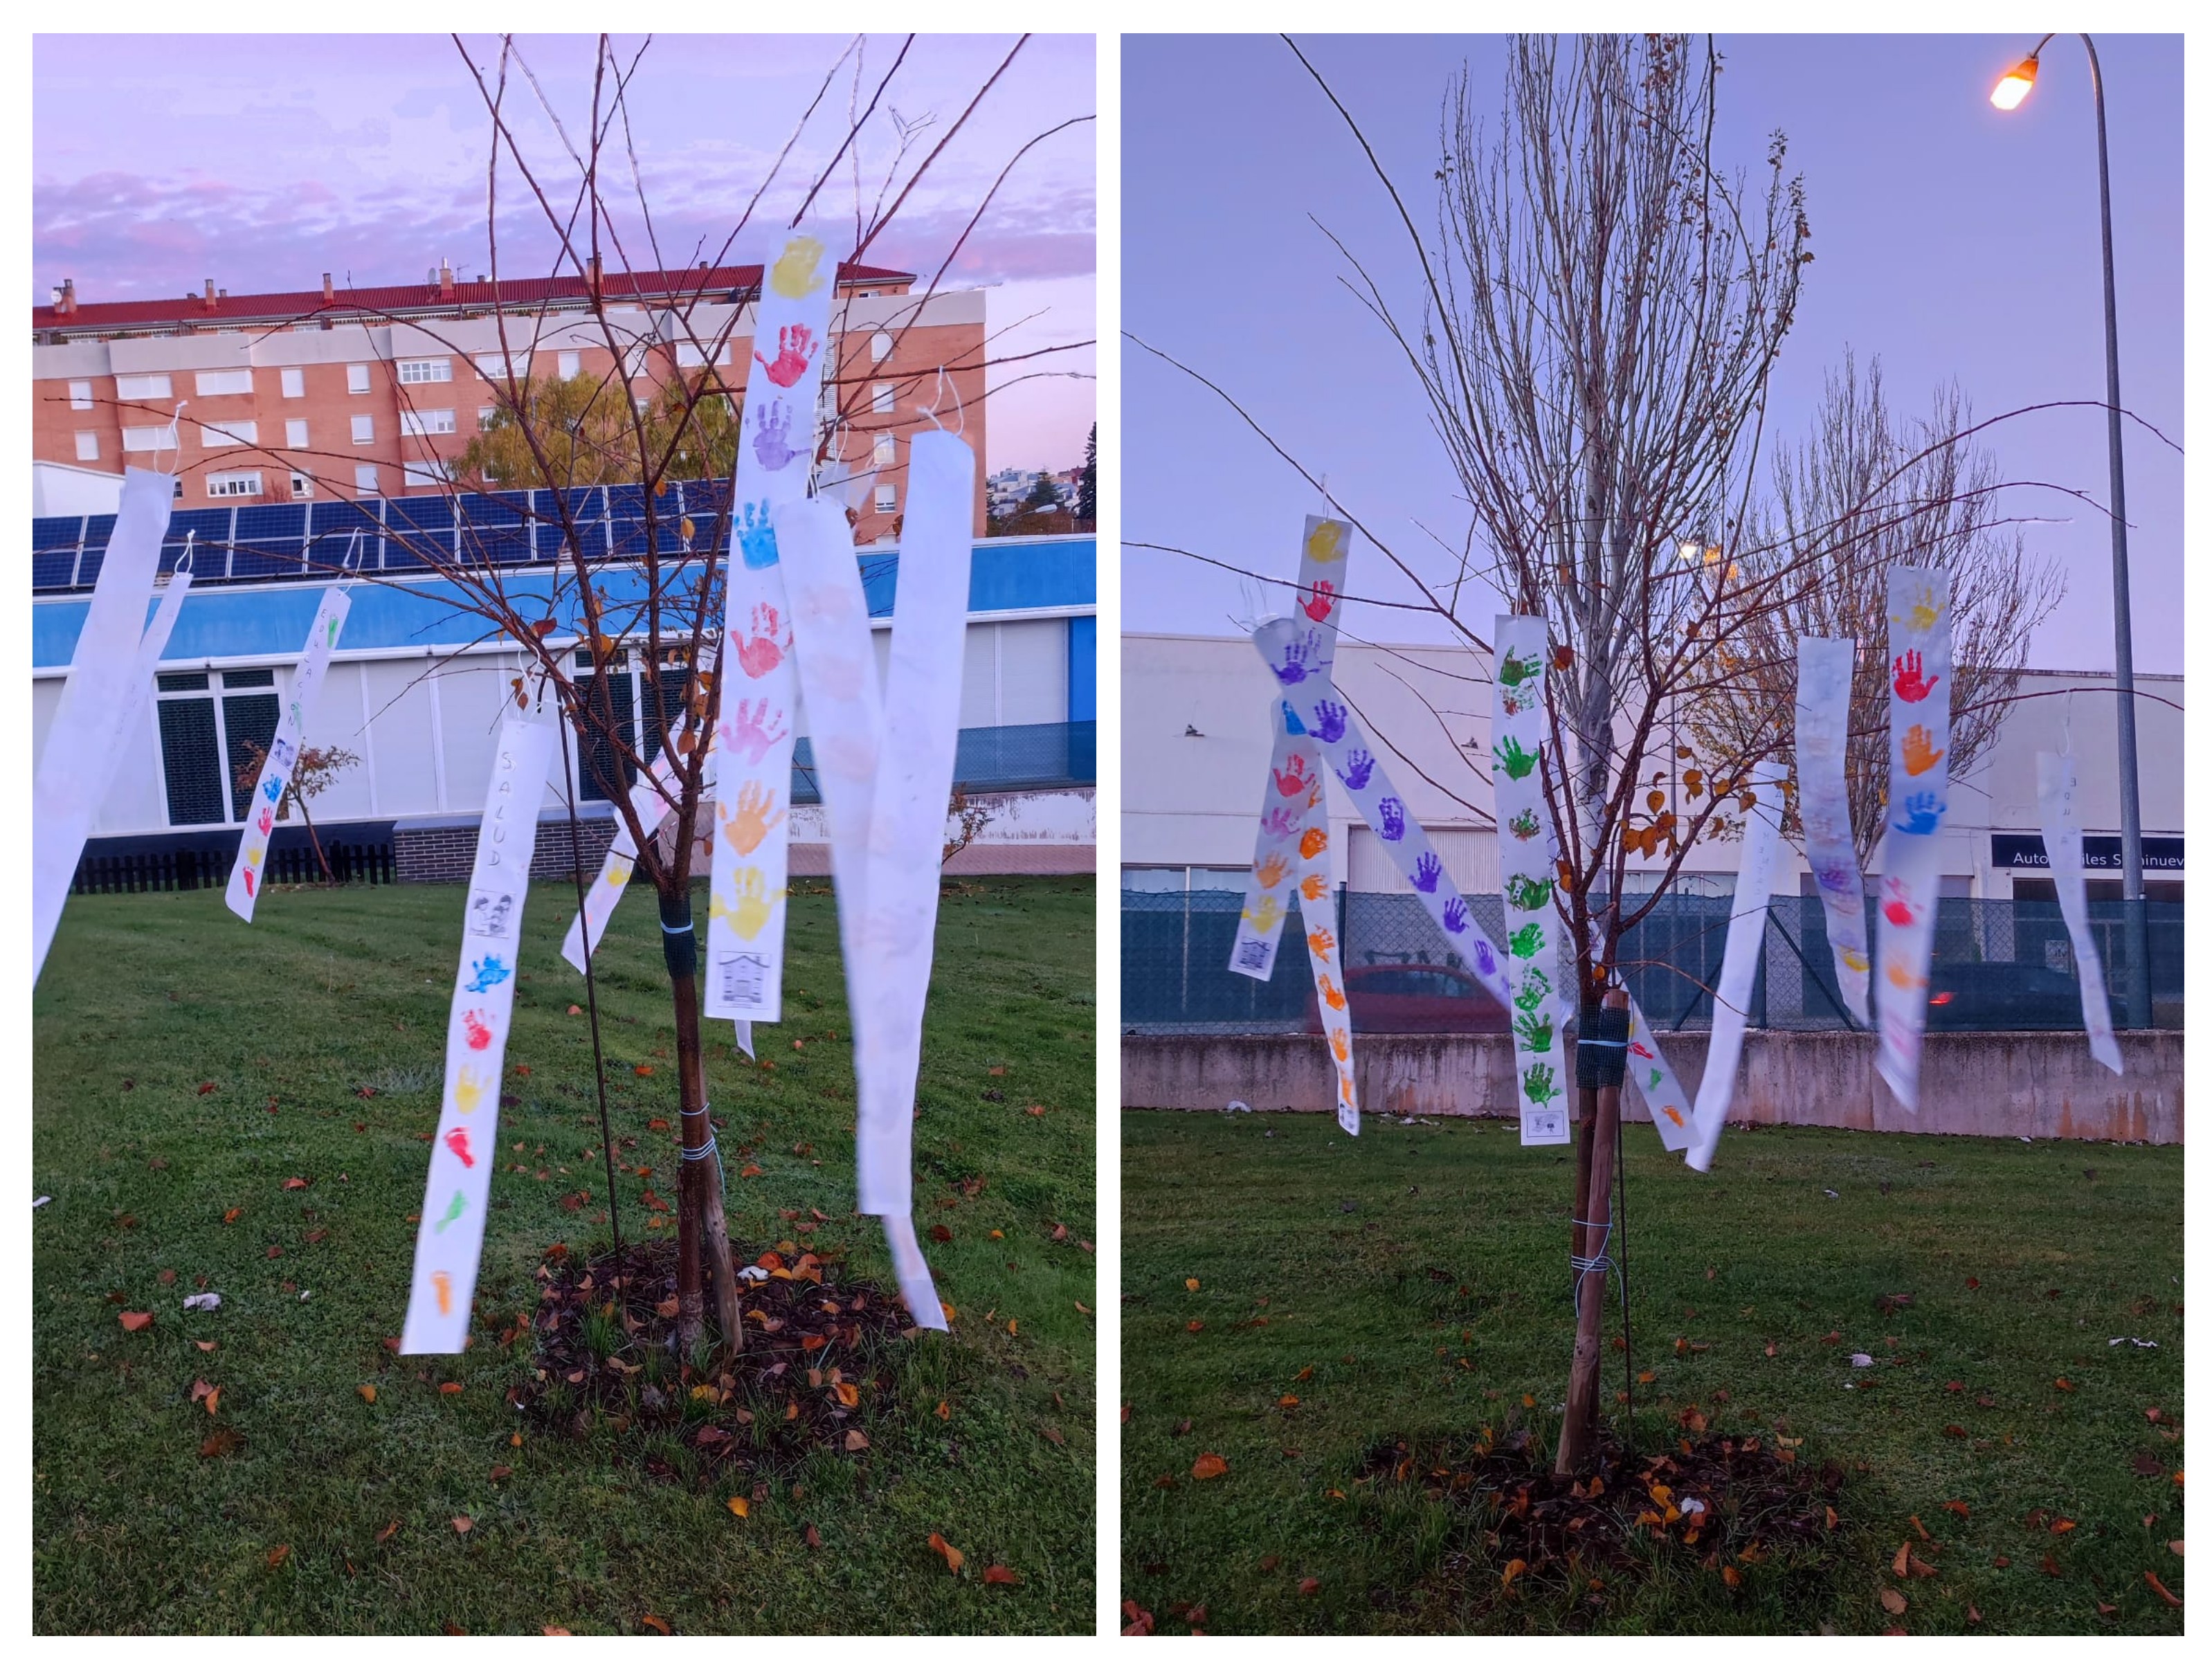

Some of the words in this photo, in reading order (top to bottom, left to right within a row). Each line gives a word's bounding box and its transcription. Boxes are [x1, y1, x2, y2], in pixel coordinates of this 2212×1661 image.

[488, 752, 514, 866] SALUD
[2013, 853, 2107, 865] Autoiles
[2113, 853, 2184, 866] Sinuev
